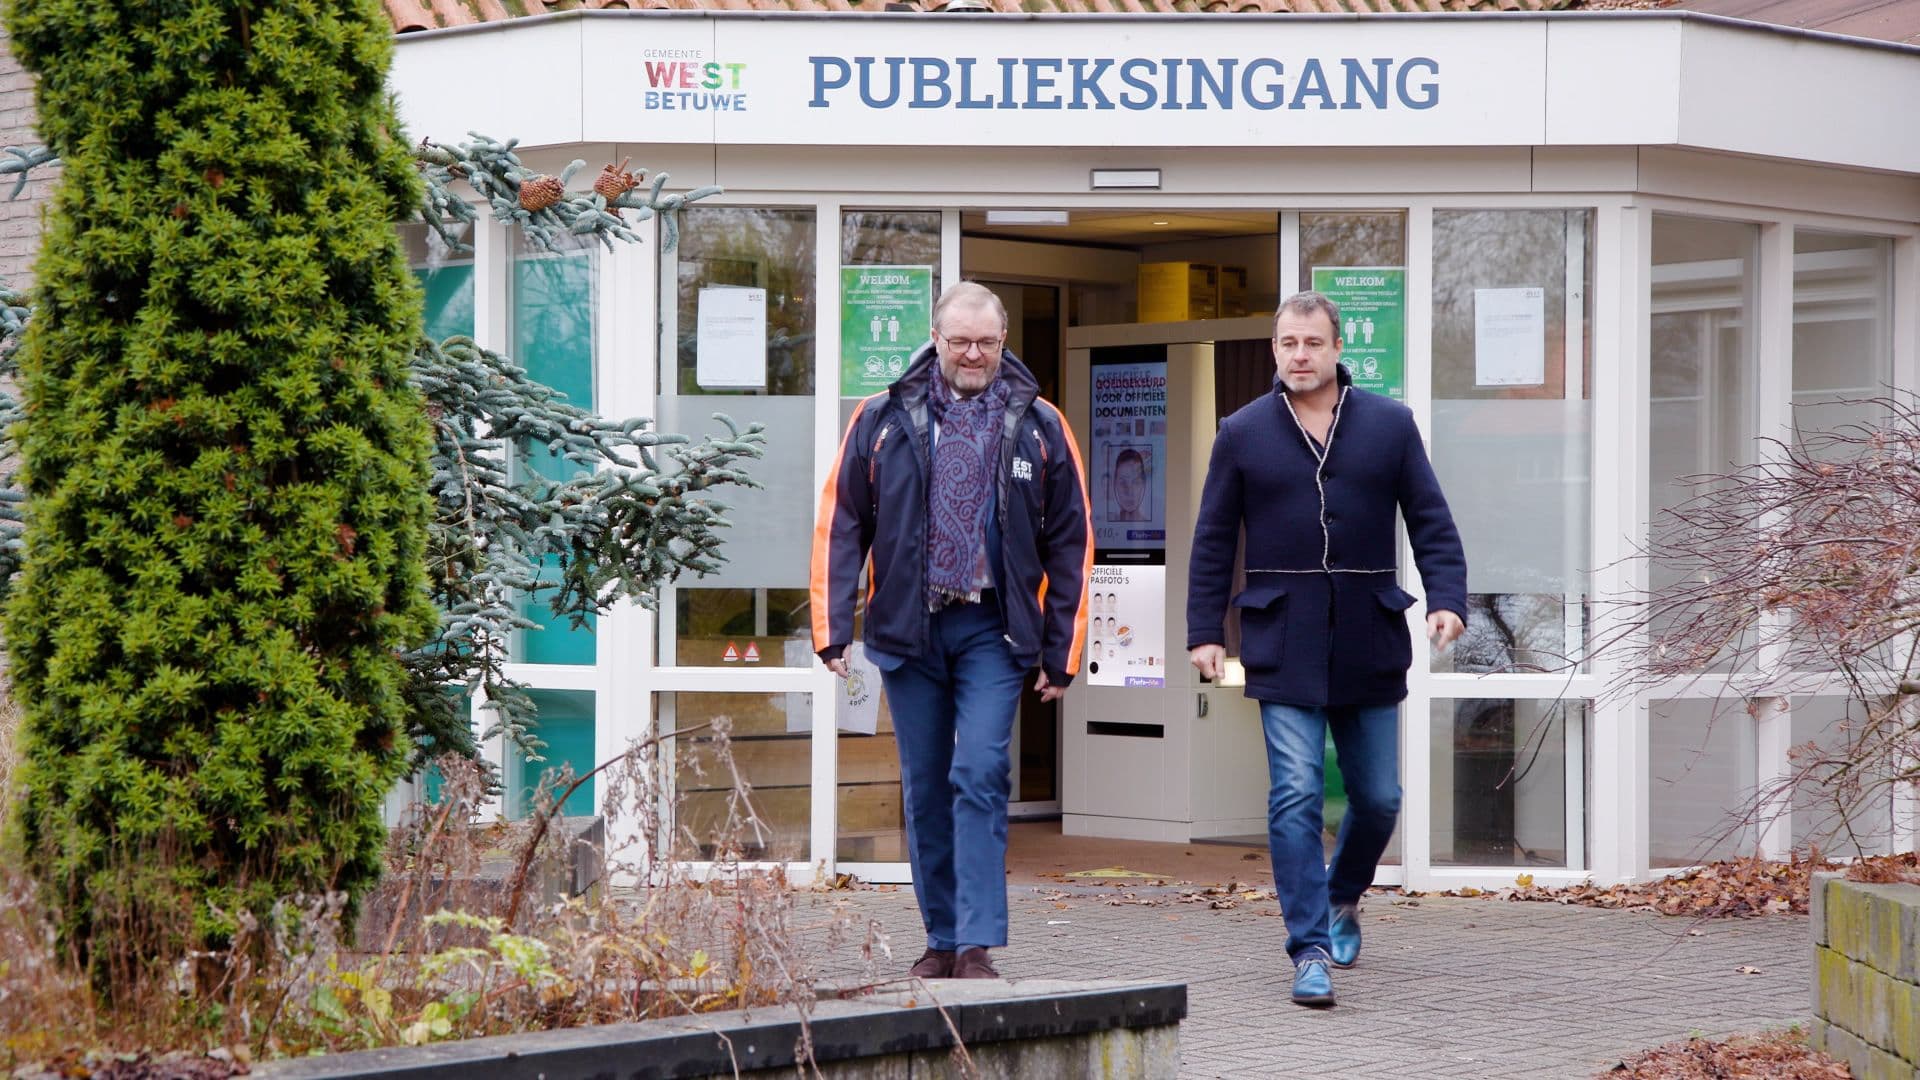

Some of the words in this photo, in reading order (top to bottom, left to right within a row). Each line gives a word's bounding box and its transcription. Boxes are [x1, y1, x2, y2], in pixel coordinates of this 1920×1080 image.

[644, 49, 702, 58] GEMEENTE
[645, 61, 747, 89] WEST
[808, 56, 1440, 110] PUBLIEKSINGANG
[645, 91, 747, 111] BETUWE
[860, 275, 910, 285] WELKOM
[1335, 276, 1385, 287] WELKOM
[1096, 393, 1122, 403] VOOR
[1096, 405, 1166, 418] DOCUMENTEN
[1013, 461, 1032, 472] EST
